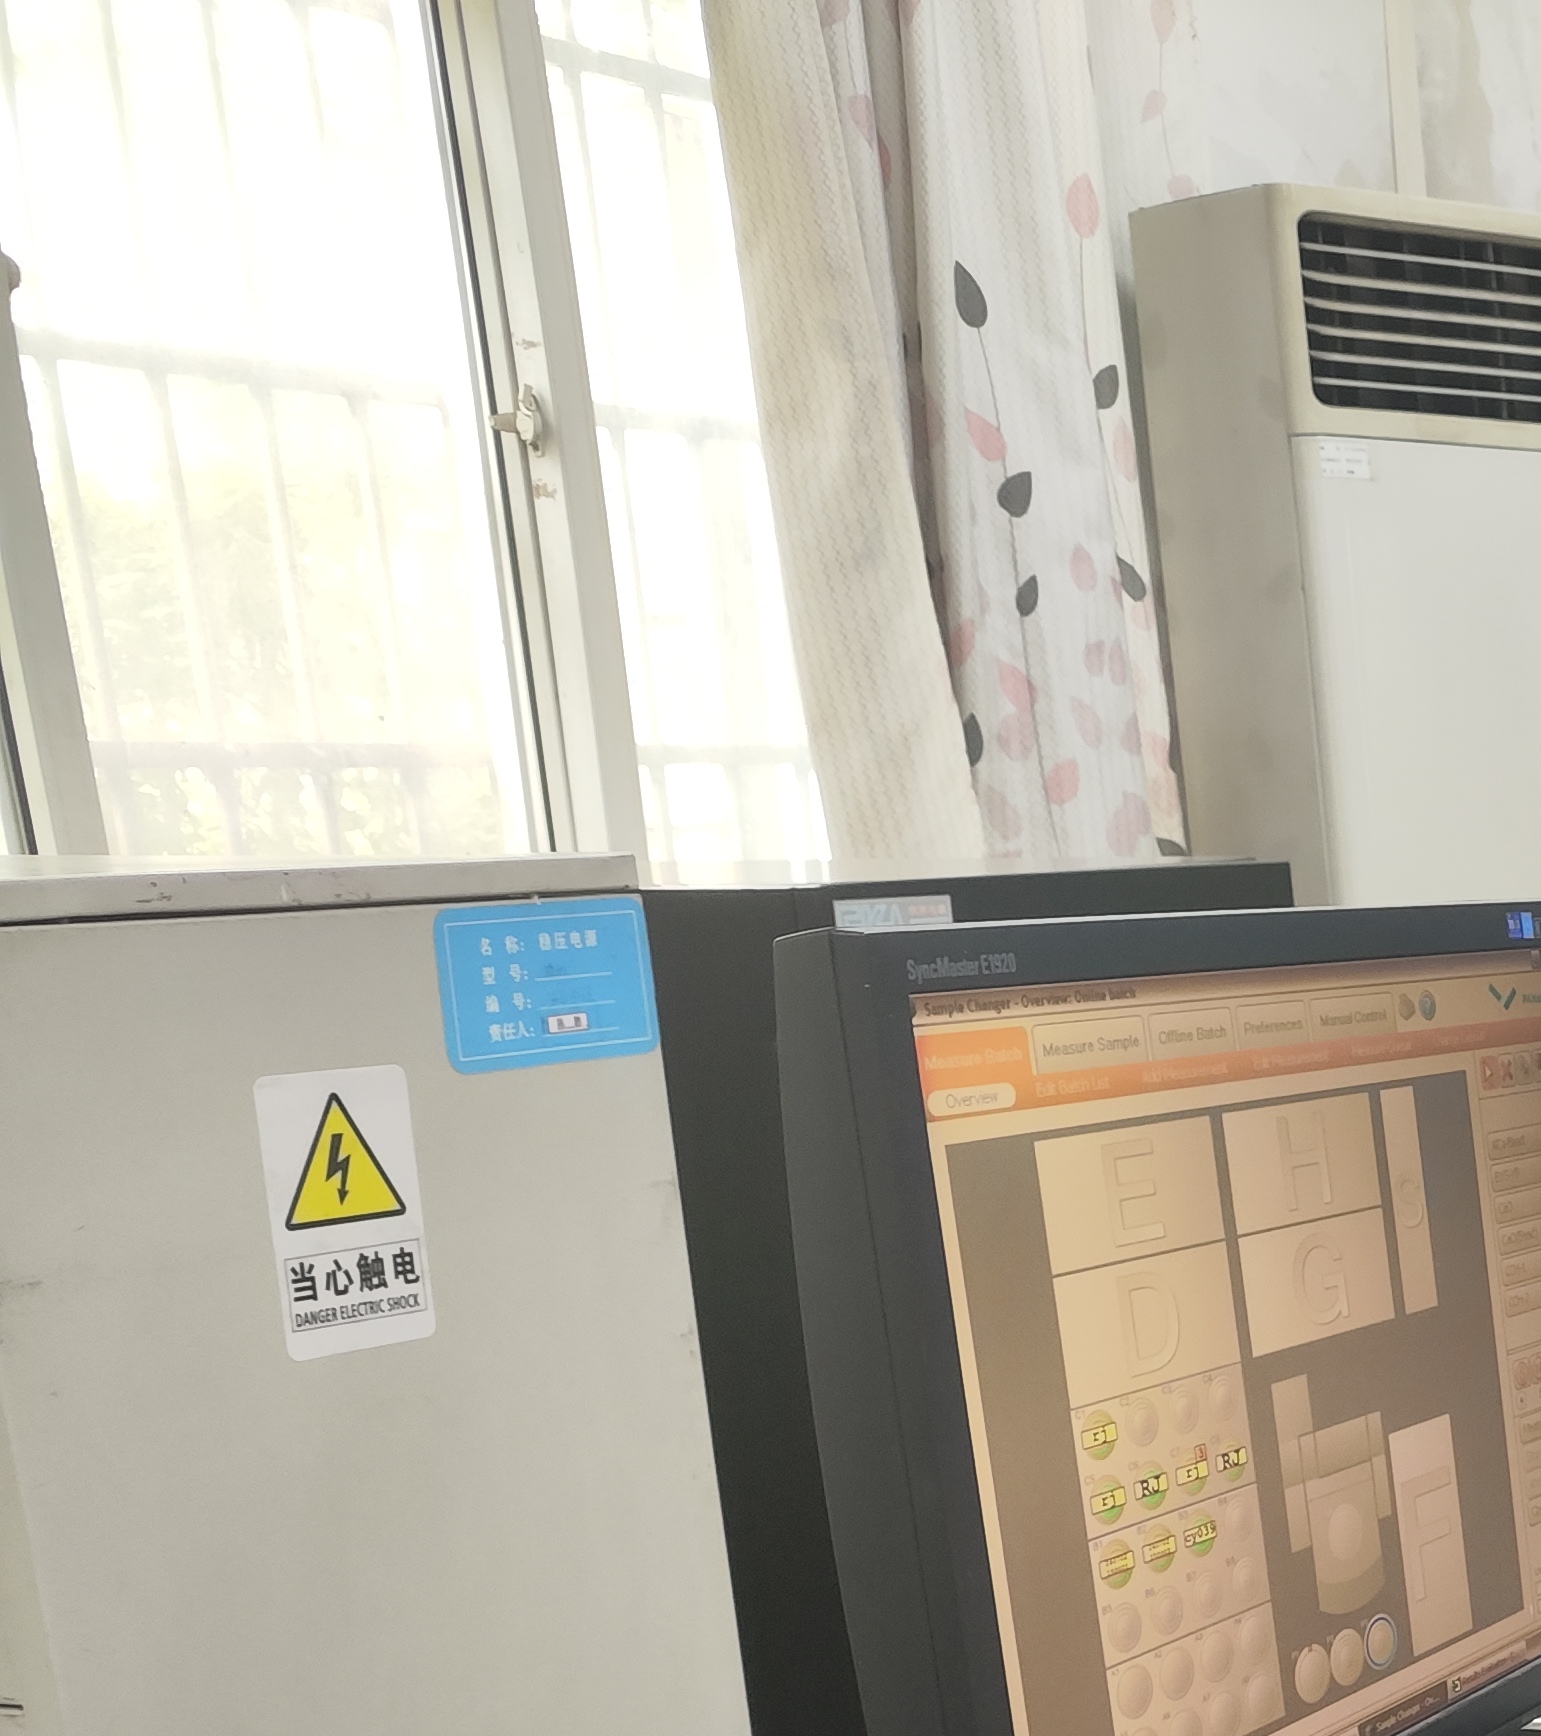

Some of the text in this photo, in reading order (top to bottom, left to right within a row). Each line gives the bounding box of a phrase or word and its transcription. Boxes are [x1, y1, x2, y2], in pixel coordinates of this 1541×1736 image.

[907, 952, 1017, 984] SyncMaster E1920
[924, 1001, 964, 1018] Sample
[967, 996, 1011, 1014] Changer
[1196, 1025, 1228, 1041] Batch
[1243, 1020, 1304, 1035] Preferences
[924, 1052, 983, 1070] Measure
[1042, 1034, 1140, 1058] Measure Sample
[944, 1090, 998, 1109] Overview
[1275, 1109, 1332, 1213] H
[1102, 1137, 1166, 1249] E
[1395, 1176, 1425, 1229] S
[290, 1246, 420, 1302] 当心触电
[1293, 1231, 1350, 1326] G
[295, 1293, 420, 1328] DANGER ELECTRIC SHOCK
[1116, 1271, 1181, 1379] D
[1223, 1448, 1241, 1470] RJ
[1140, 1474, 1162, 1495] RJ
[1400, 1464, 1452, 1602] F
